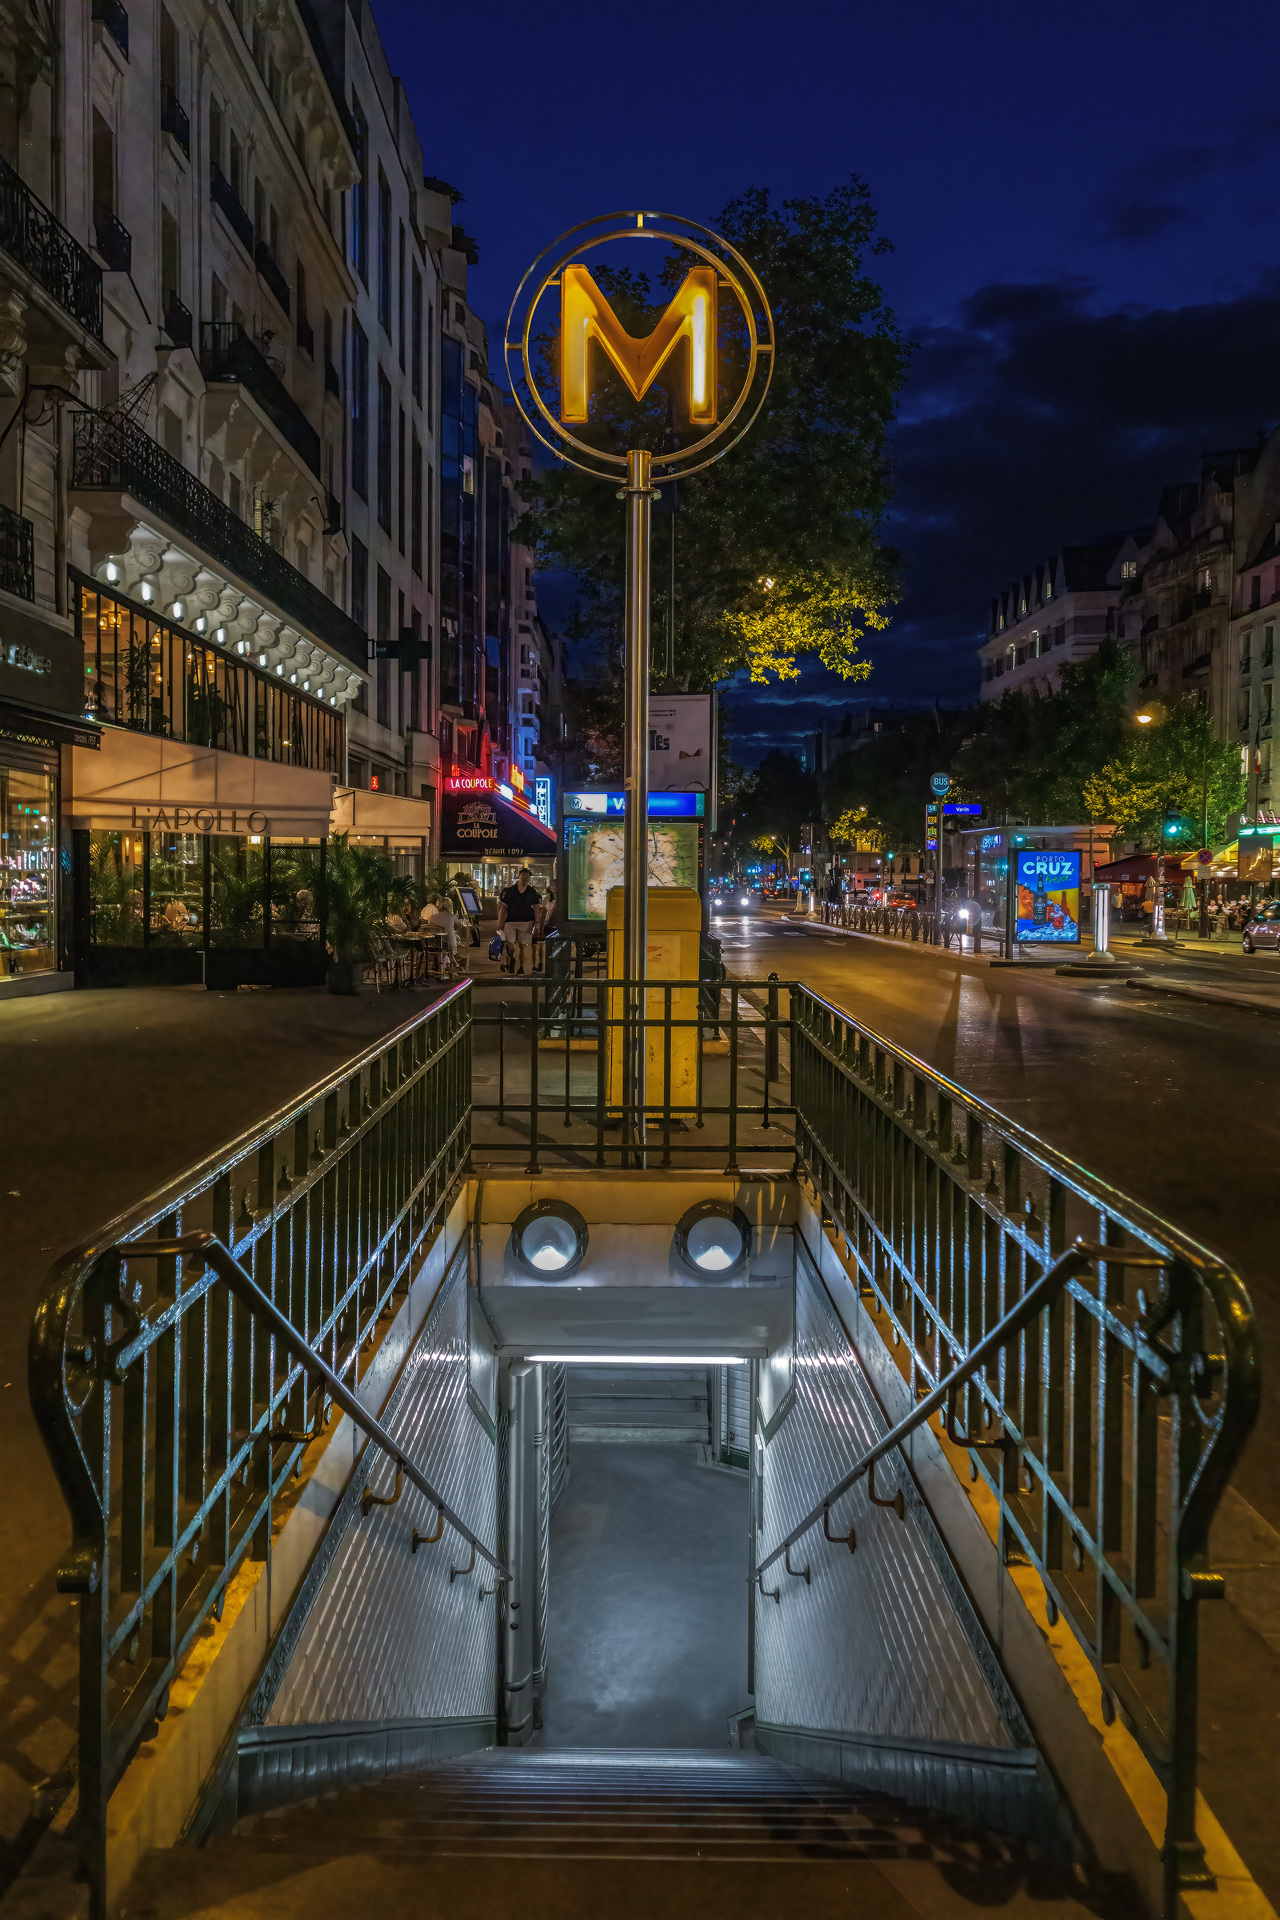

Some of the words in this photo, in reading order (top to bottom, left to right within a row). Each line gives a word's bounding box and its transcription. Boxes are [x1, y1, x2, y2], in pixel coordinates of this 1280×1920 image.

[560, 264, 718, 424] M
[450, 779, 460, 789] LA
[461, 778, 492, 789] COUPOLE
[933, 777, 948, 786] BUS
[131, 806, 268, 834] L'APOLLO
[457, 828, 498, 839] COUPOLE
[1036, 855, 1066, 863] PORTO
[1022, 861, 1073, 876] CRUZ
